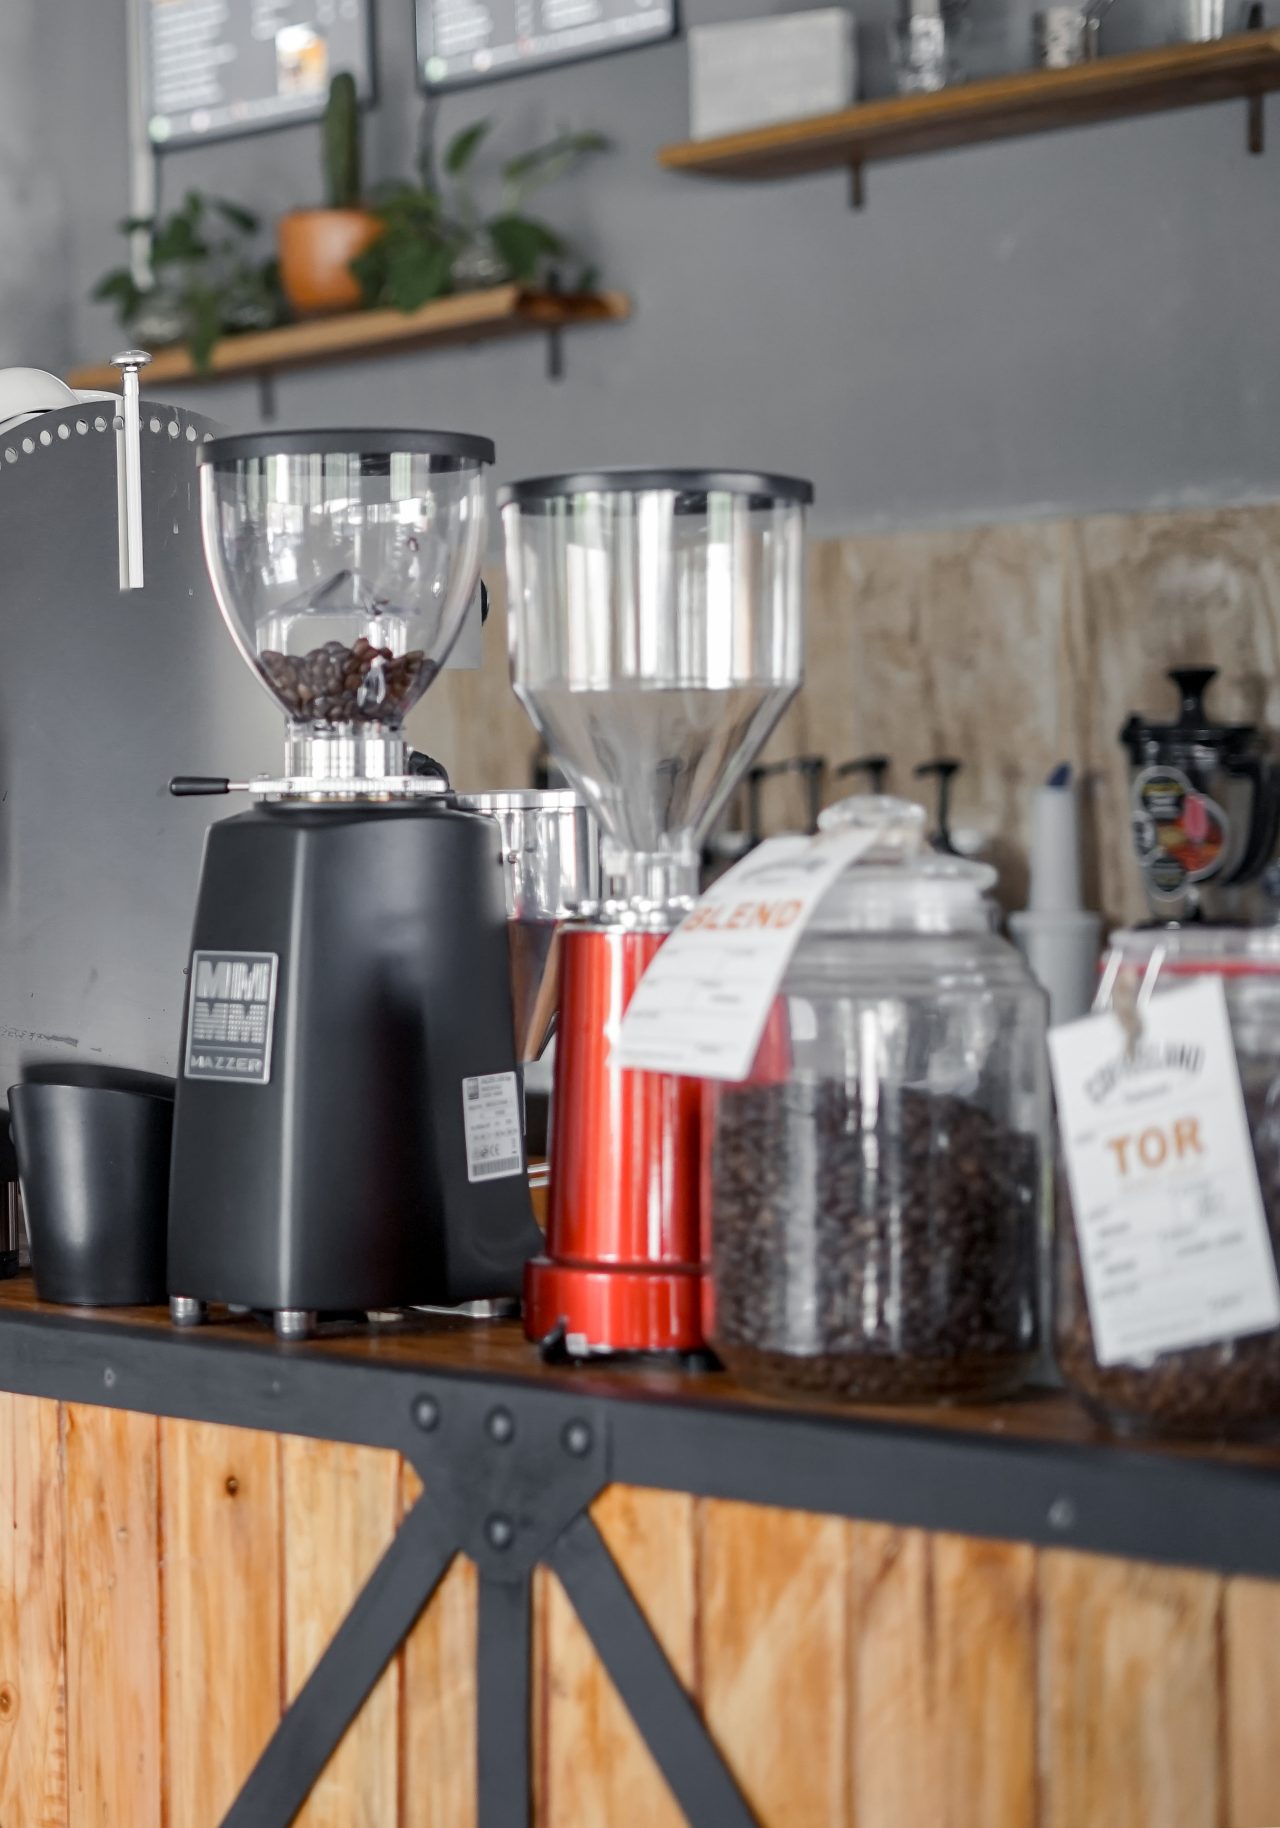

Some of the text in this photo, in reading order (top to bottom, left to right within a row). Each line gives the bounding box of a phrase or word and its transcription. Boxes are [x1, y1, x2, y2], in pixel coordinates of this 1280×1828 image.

[683, 899, 803, 931] BLEND
[190, 1055, 263, 1072] MAZZER
[1107, 1115, 1204, 1175] TOR
